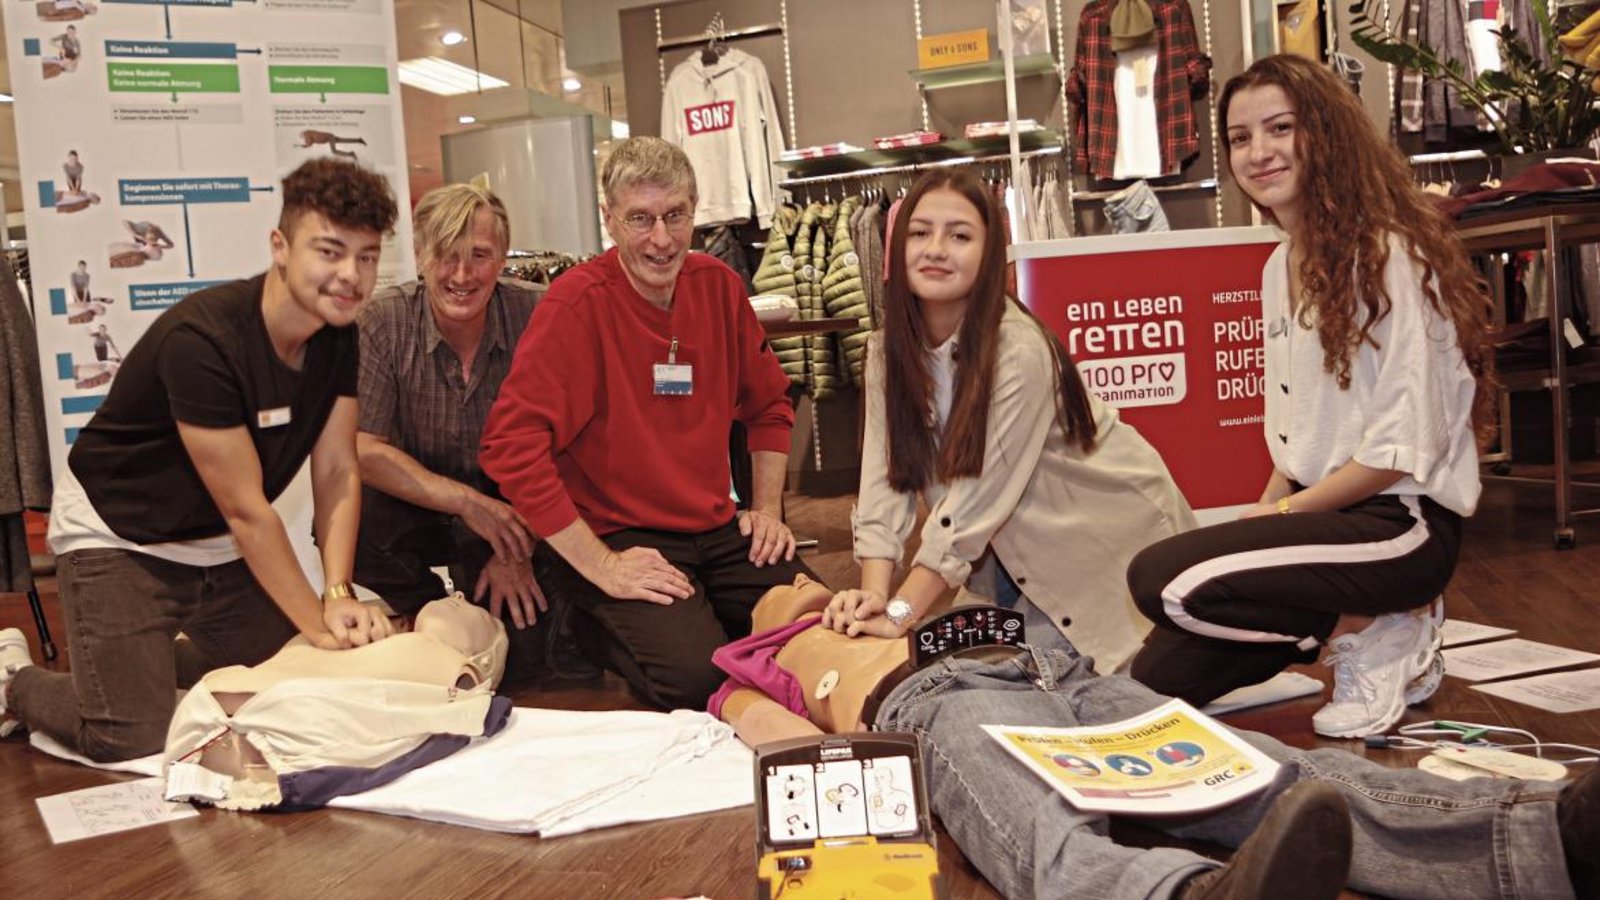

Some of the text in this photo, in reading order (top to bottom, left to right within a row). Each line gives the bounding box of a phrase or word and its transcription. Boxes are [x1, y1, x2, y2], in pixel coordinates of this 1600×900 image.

[930, 46, 948, 56] ONLY
[957, 41, 977, 53] SONS
[690, 104, 730, 131] SONS
[1212, 290, 1263, 304] HERZSTIL
[1214, 316, 1264, 343] PRÜF
[1216, 347, 1265, 372] RUFE
[1082, 366, 1125, 388] 100
[1094, 386, 1175, 402] animation
[1218, 373, 1265, 400] DRÜC
[1124, 717, 1180, 740] Drücken
[768, 766, 775, 776] 1
[815, 763, 824, 772] 2
[863, 759, 871, 768] 3
[1204, 769, 1235, 786] GRC
